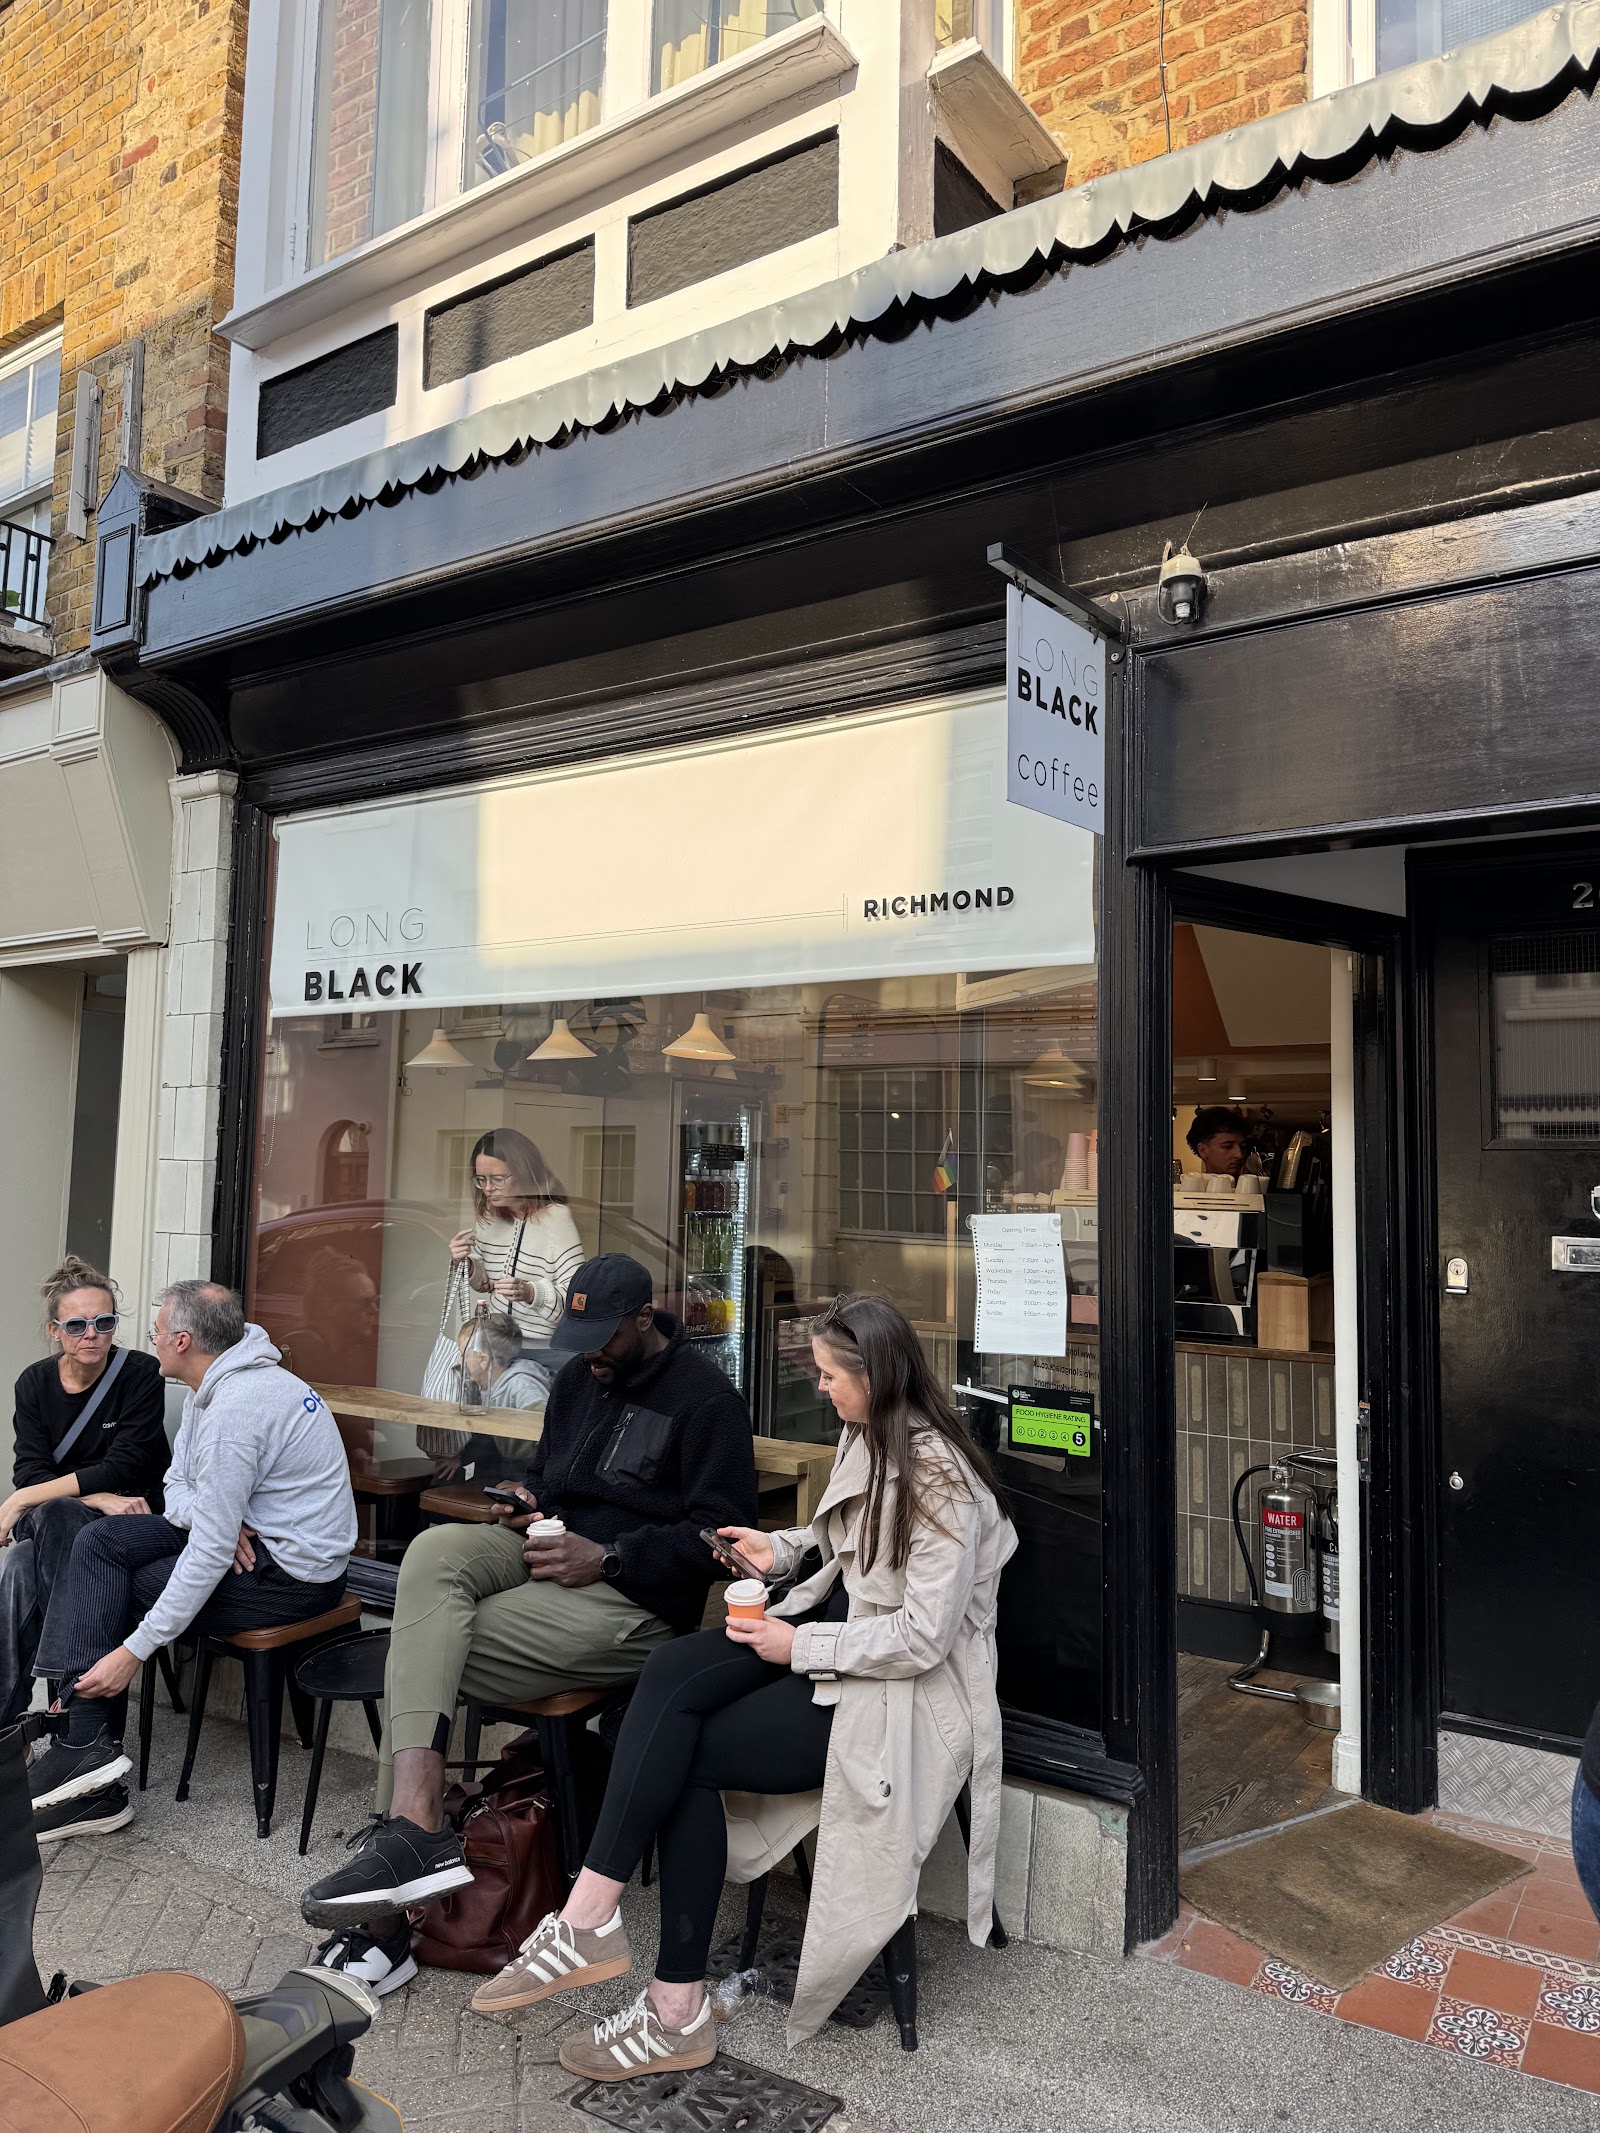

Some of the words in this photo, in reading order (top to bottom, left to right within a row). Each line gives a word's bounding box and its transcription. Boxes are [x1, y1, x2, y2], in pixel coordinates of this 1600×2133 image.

[1017, 626, 1098, 696] LONG
[1017, 666, 1098, 735] BLACK
[864, 887, 1014, 918] RICHMOND
[307, 908, 423, 950] LONG
[304, 962, 423, 1001] BLACK
[1015, 1408, 1035, 1417] FOOD
[1035, 1410, 1062, 1420] HYGIENE
[1063, 1414, 1086, 1423] RATING
[1075, 1433, 1084, 1445] 5
[1267, 1512, 1297, 1526] WATER
